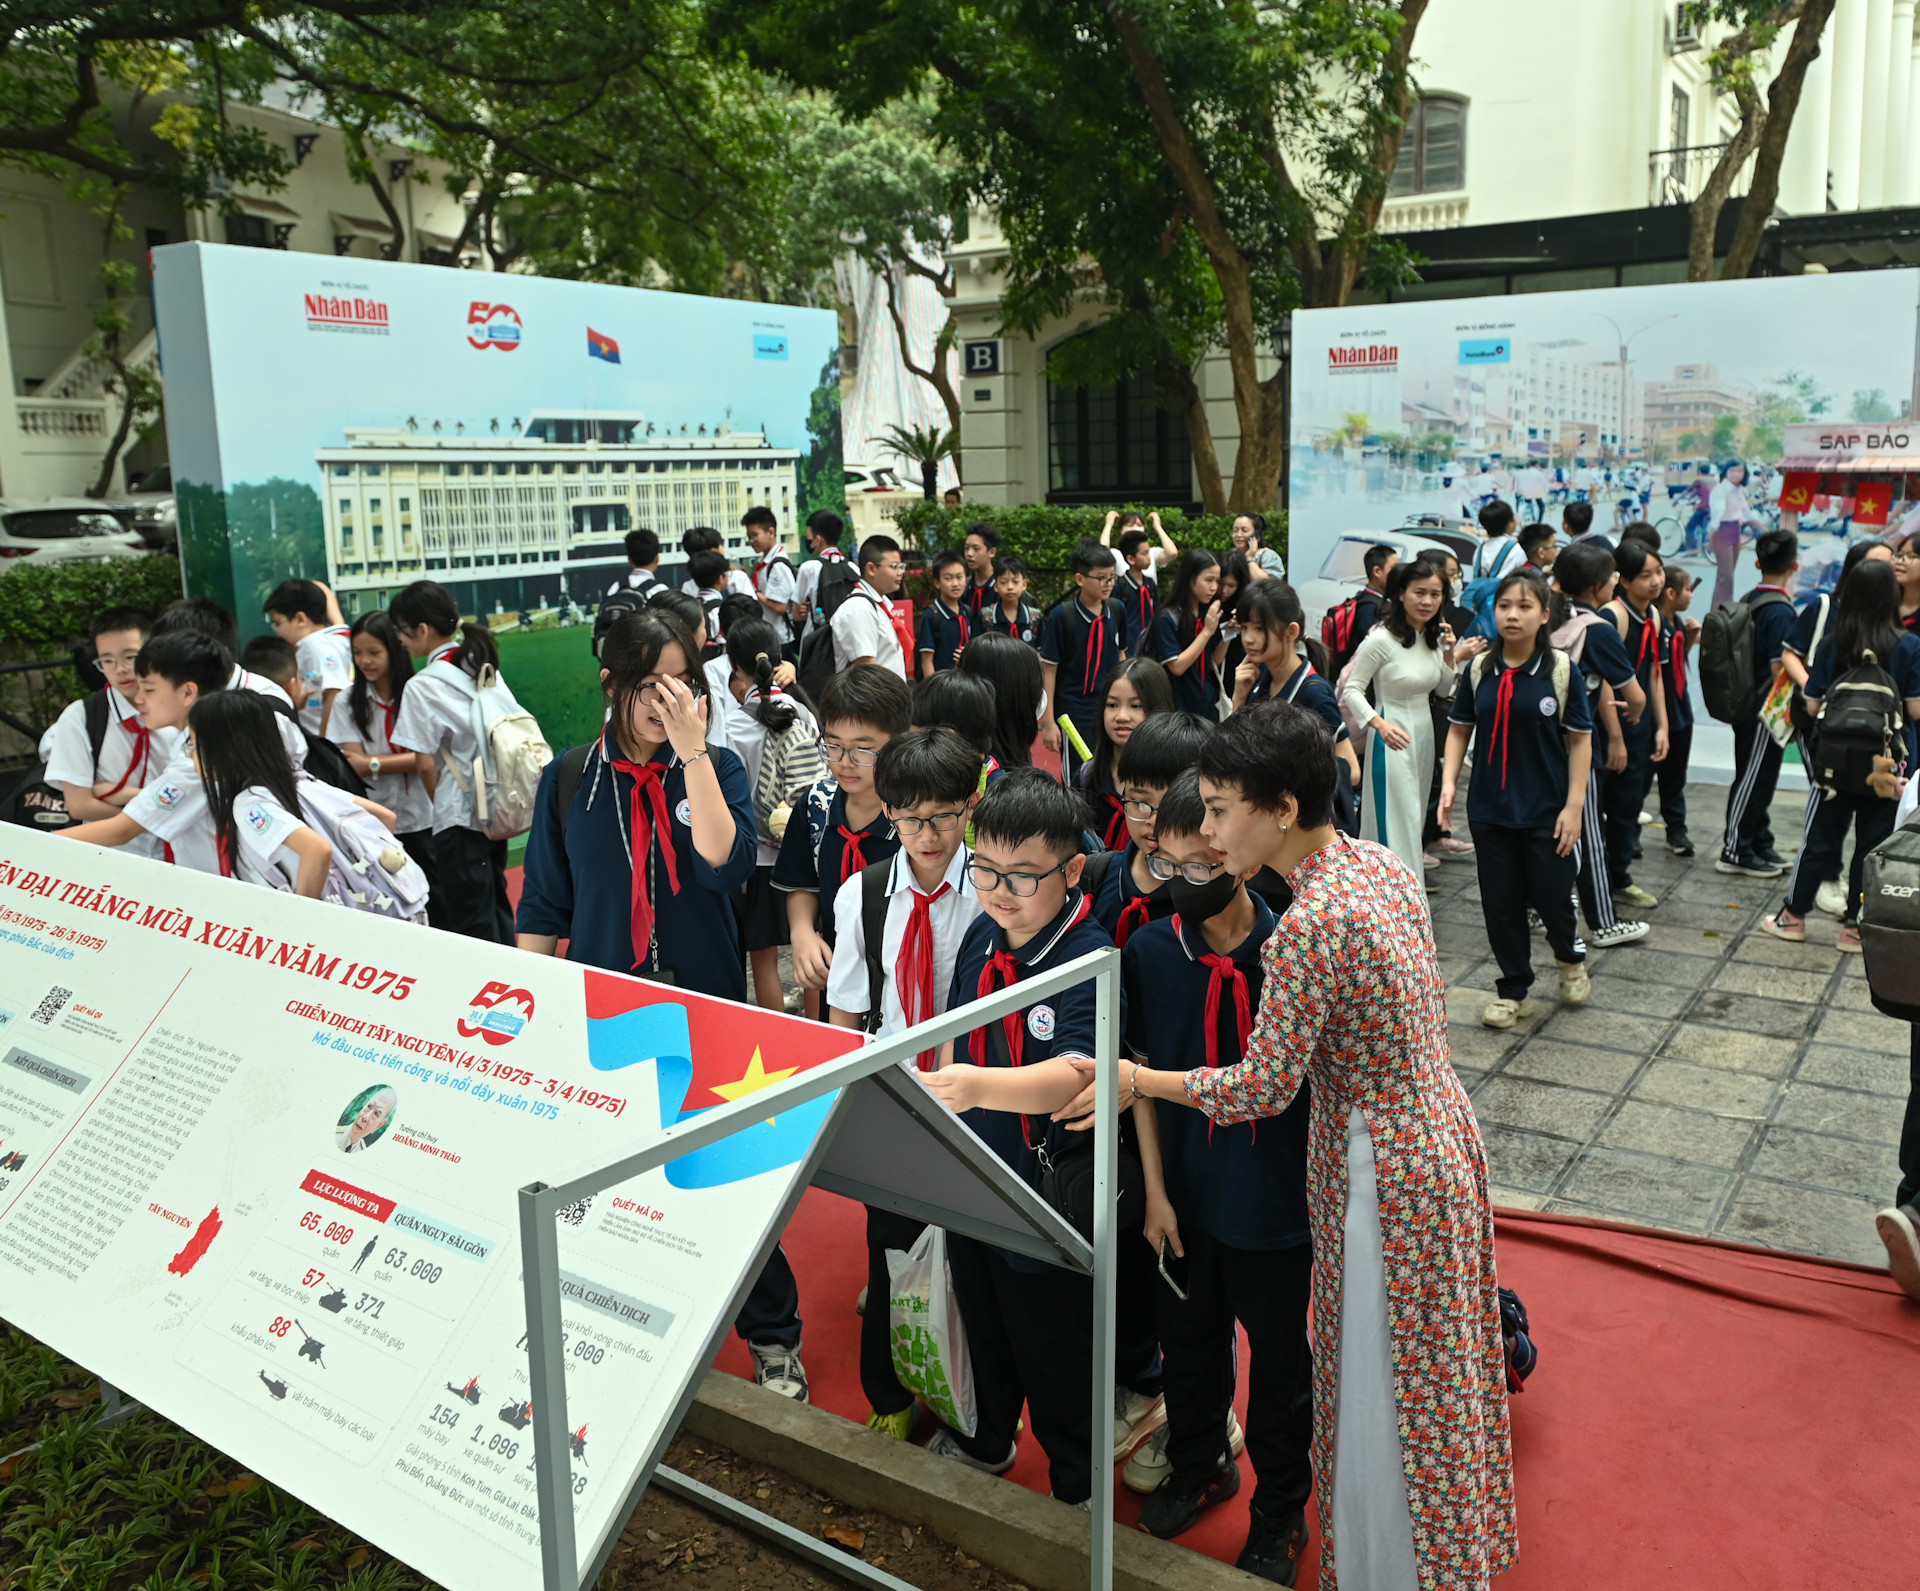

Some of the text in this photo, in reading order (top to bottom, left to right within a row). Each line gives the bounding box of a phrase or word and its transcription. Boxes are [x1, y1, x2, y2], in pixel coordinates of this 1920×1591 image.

[304, 293, 389, 321] Nhân Dân
[467, 301, 523, 352] 50
[971, 346, 993, 370] B
[1328, 343, 1399, 364] Nhân Dân
[1880, 883, 1920, 898] acer
[7, 933, 27, 944] phía
[26, 937, 42, 949] Bắc
[41, 942, 56, 954] của
[55, 947, 74, 960] địch
[17, 872, 62, 897] ĐẠI
[58, 883, 140, 921] THẮNG
[136, 906, 193, 938] MÙA
[194, 921, 274, 959] XUÂN
[269, 943, 342, 980] NĂM
[339, 963, 417, 1000] 1975
[49, 926, 107, 953] 26/3/1975)
[457, 981, 535, 1046] 50
[14, 1056, 77, 1086] KẾT QUẢ CHIẾN DỊCH
[286, 1000, 331, 1022] CHIẾN
[327, 1013, 367, 1034] DỊCH
[366, 1024, 395, 1042] TÂY
[392, 1033, 459, 1063] NGUYÊN
[456, 1051, 534, 1085] (4/3/1975
[544, 1079, 626, 1117] 3/4/1975)
[312, 1032, 560, 1120] Mở đầu cuộc tiến công và nổi dậy xuân 1975
[392, 1134, 461, 1163] HOÀNG MINH THẢO
[399, 1124, 417, 1137] Tướng
[426, 1134, 438, 1144] huy
[313, 1180, 379, 1214] LỰC LƯỢNG TA
[613, 1198, 664, 1221] QUÉT MÃ QR
[147, 1202, 193, 1229] TÂY NGUYÊN
[300, 1212, 353, 1244] 65.000
[395, 1214, 487, 1257] QUÂN NGỤY SÀI GÒN
[322, 1247, 340, 1259] quân
[384, 1248, 442, 1284] 63.000
[248, 1270, 257, 1278] xe
[272, 1282, 282, 1290] xe
[281, 1284, 295, 1296] bọc
[294, 1291, 310, 1305] thép
[302, 1268, 325, 1288] 57
[374, 1270, 392, 1282] quân
[355, 1293, 385, 1319] 371
[561, 1282, 585, 1298] QUẢ
[585, 1291, 621, 1312] CHIẾN
[619, 1305, 650, 1324] DỊCH
[231, 1322, 276, 1352] khẩu pháo lớn
[269, 1316, 291, 1337] 88
[344, 1317, 353, 1325] xe
[371, 1328, 389, 1342] thiết
[387, 1338, 404, 1351] giáp
[561, 1320, 652, 1362] oại khỏi vòng chiến đấu
[514, 1369, 528, 1383] Thu
[292, 1392, 375, 1441] vài trăm máy bay các loại
[429, 1404, 460, 1429] 154
[418, 1424, 450, 1446] máy bay
[470, 1425, 519, 1459] 1.096
[463, 1448, 505, 1474] xe quân sự
[406, 1443, 421, 1456] Giải
[417, 1452, 442, 1470] phóng
[440, 1461, 448, 1471] 5
[446, 1464, 461, 1479] tỉnh
[460, 1473, 475, 1487] Kon
[476, 1480, 492, 1498] Tum,
[494, 1491, 506, 1504] Gia
[506, 1497, 520, 1510] Lai,
[521, 1505, 536, 1518] Đắk
[513, 1474, 532, 1491] súng
[395, 1459, 411, 1472] Phú
[409, 1466, 424, 1483] Bổn,
[426, 1475, 449, 1496] Quảng
[449, 1488, 464, 1503] Đức
[465, 1498, 474, 1508] và
[473, 1504, 489, 1517] một
[488, 1512, 500, 1522] số
[498, 1515, 514, 1530] tỉnh
[515, 1523, 536, 1545] Trung
